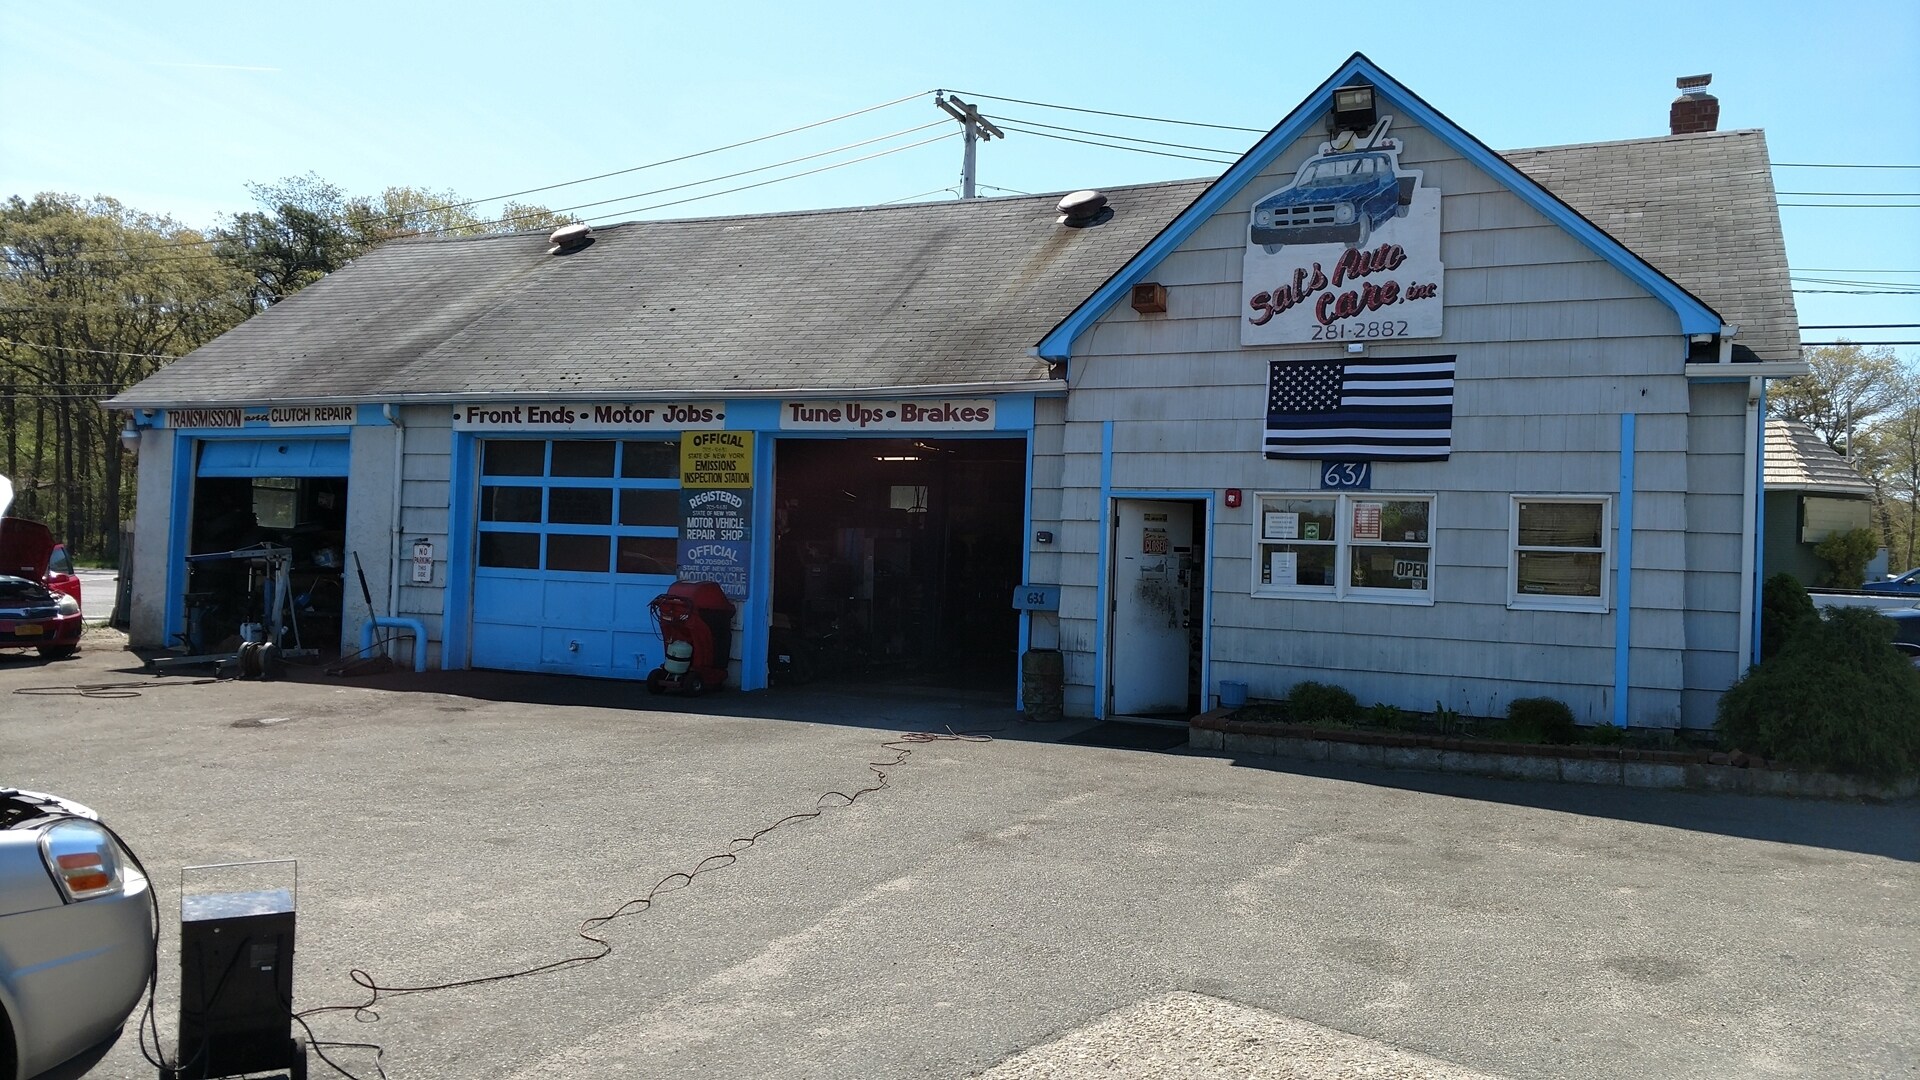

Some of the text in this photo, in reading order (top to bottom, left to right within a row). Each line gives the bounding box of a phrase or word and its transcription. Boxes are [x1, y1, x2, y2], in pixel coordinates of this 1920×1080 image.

[1249, 243, 1408, 326] Sal's Auto
[1311, 320, 1409, 340] 281-2882
[168, 406, 352, 427] TRANSMISSION and CLUTCH REPAIR
[467, 405, 713, 424] Front Ends Motor Jobs
[789, 403, 990, 427] Tune Ups Brakes
[693, 433, 744, 448] OFFICIAL
[695, 460, 737, 471] EMISSIONS
[684, 472, 750, 483] INSPECTION STATION
[1324, 463, 1367, 486] 631
[688, 490, 743, 509] REGISTERED
[686, 517, 744, 529] MOTOR VEHICLE
[686, 529, 744, 541] REPAIR SHOP
[419, 547, 428, 556] NO
[687, 544, 738, 562] OFFICIAL
[1144, 540, 1167, 552] CLOSED
[679, 571, 747, 583] MOTORCYCLE
[1396, 561, 1427, 578] OPEN
[1027, 592, 1045, 605] 631
